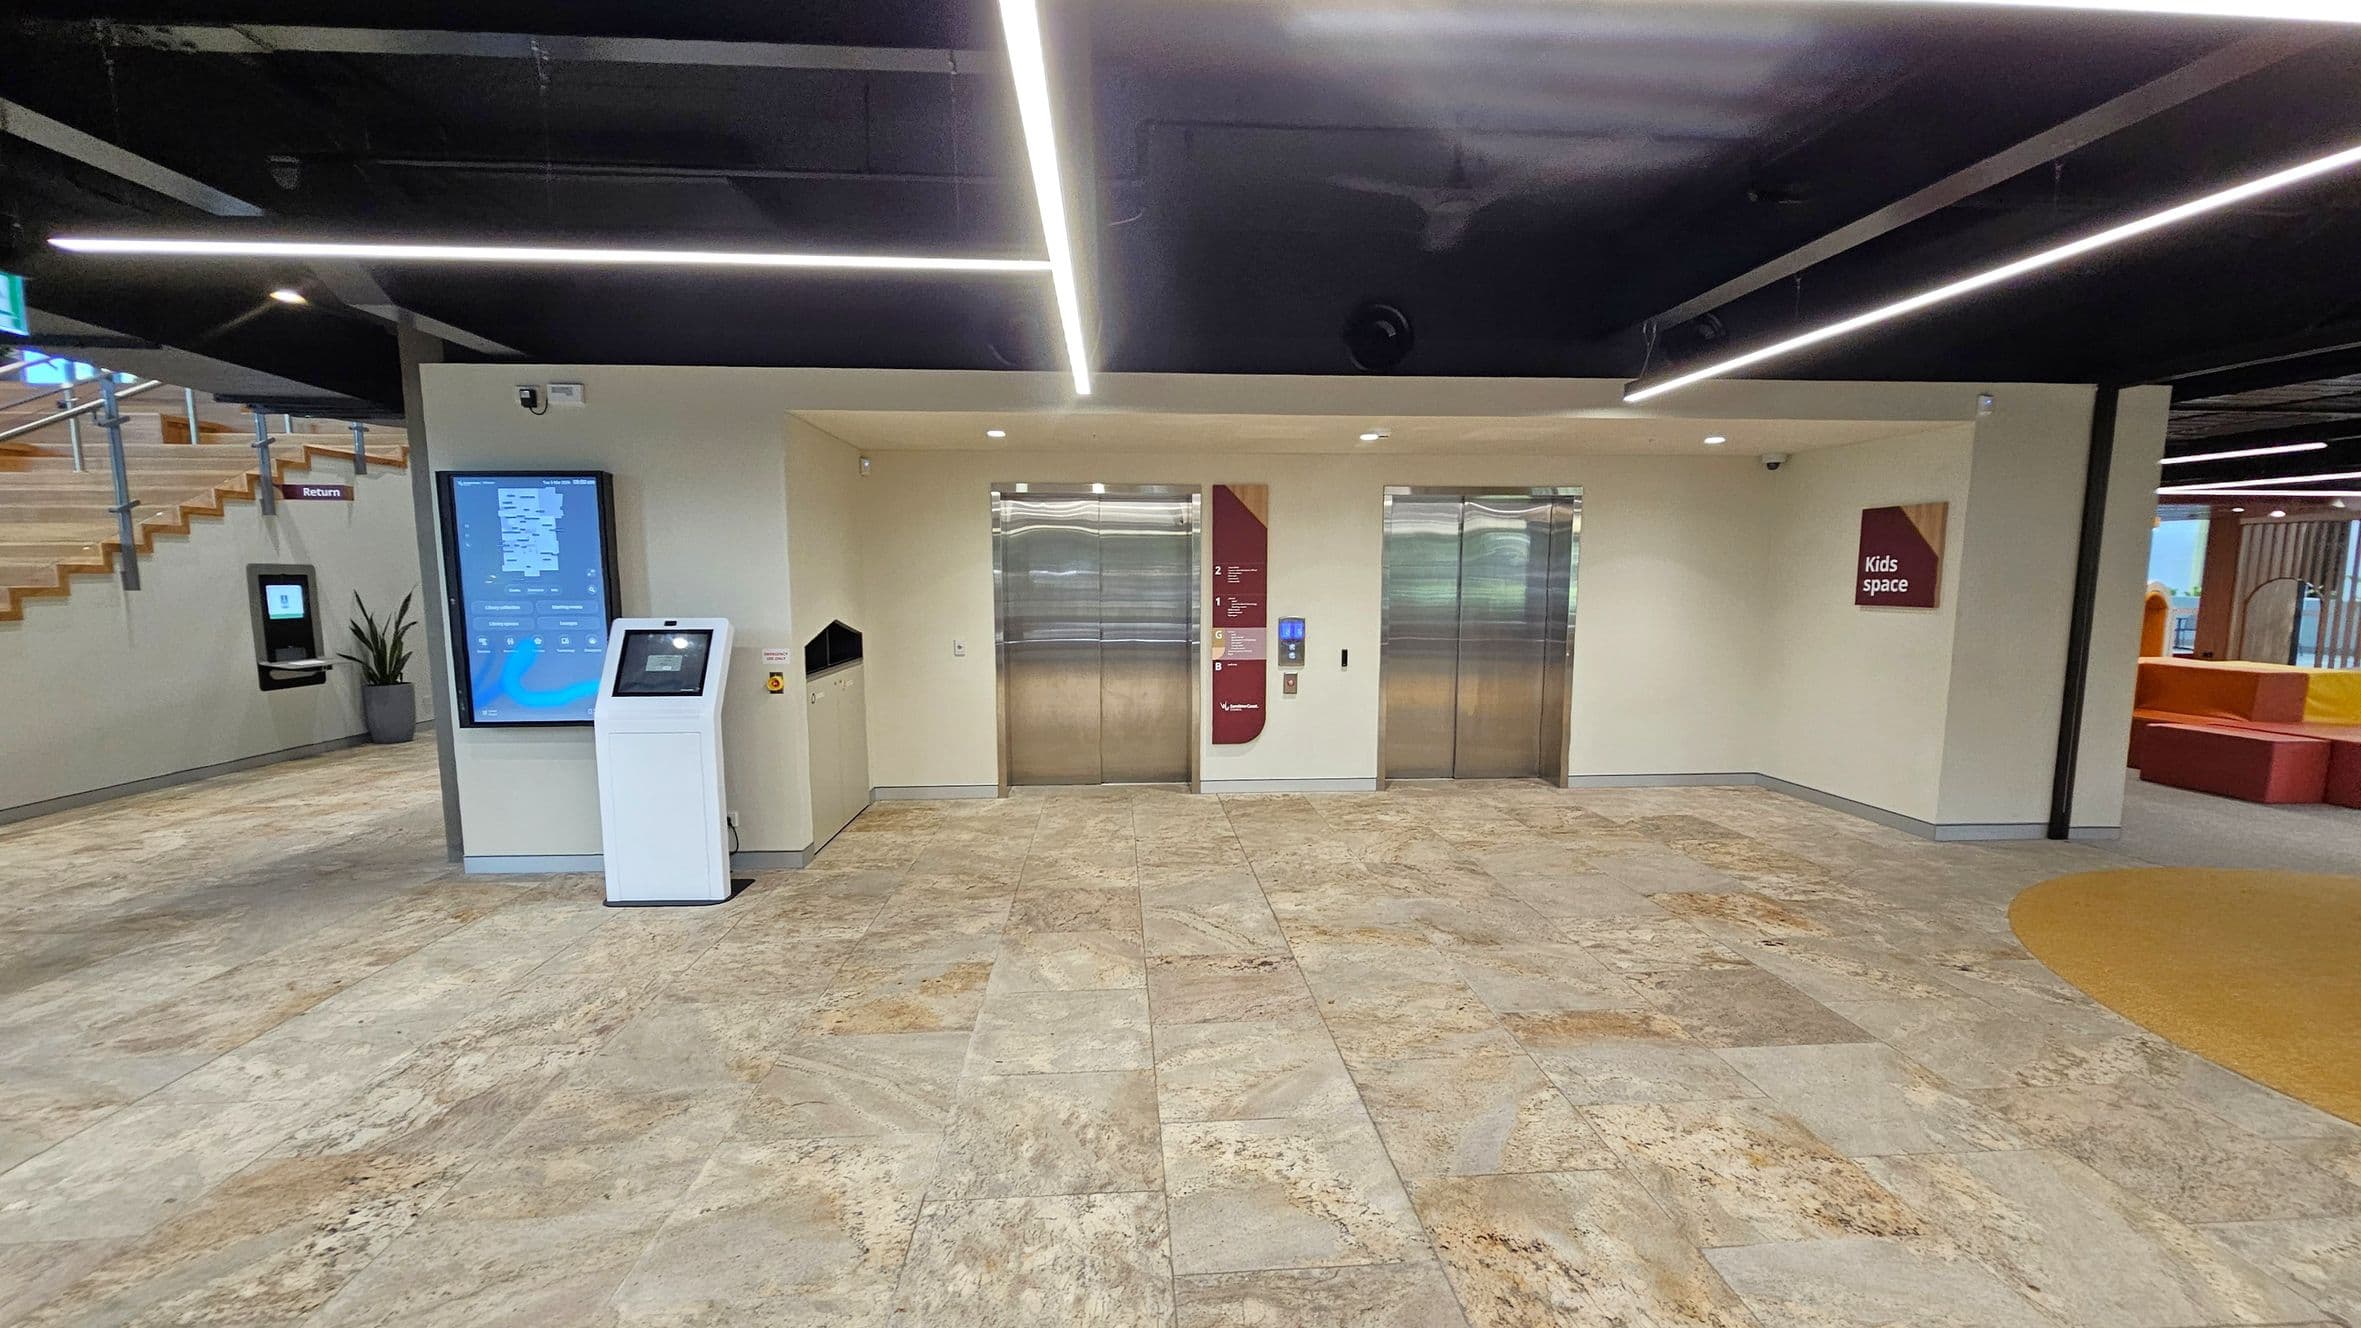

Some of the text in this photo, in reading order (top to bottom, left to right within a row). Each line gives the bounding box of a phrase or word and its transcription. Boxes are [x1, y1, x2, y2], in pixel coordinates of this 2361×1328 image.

[303, 487, 340, 497] Return
[1865, 555, 1898, 572] Kids
[1215, 566, 1221, 575] 2
[1863, 579, 1908, 596] space
[1215, 597, 1221, 606] 1
[1215, 631, 1222, 639] G
[1215, 662, 1222, 671] B
